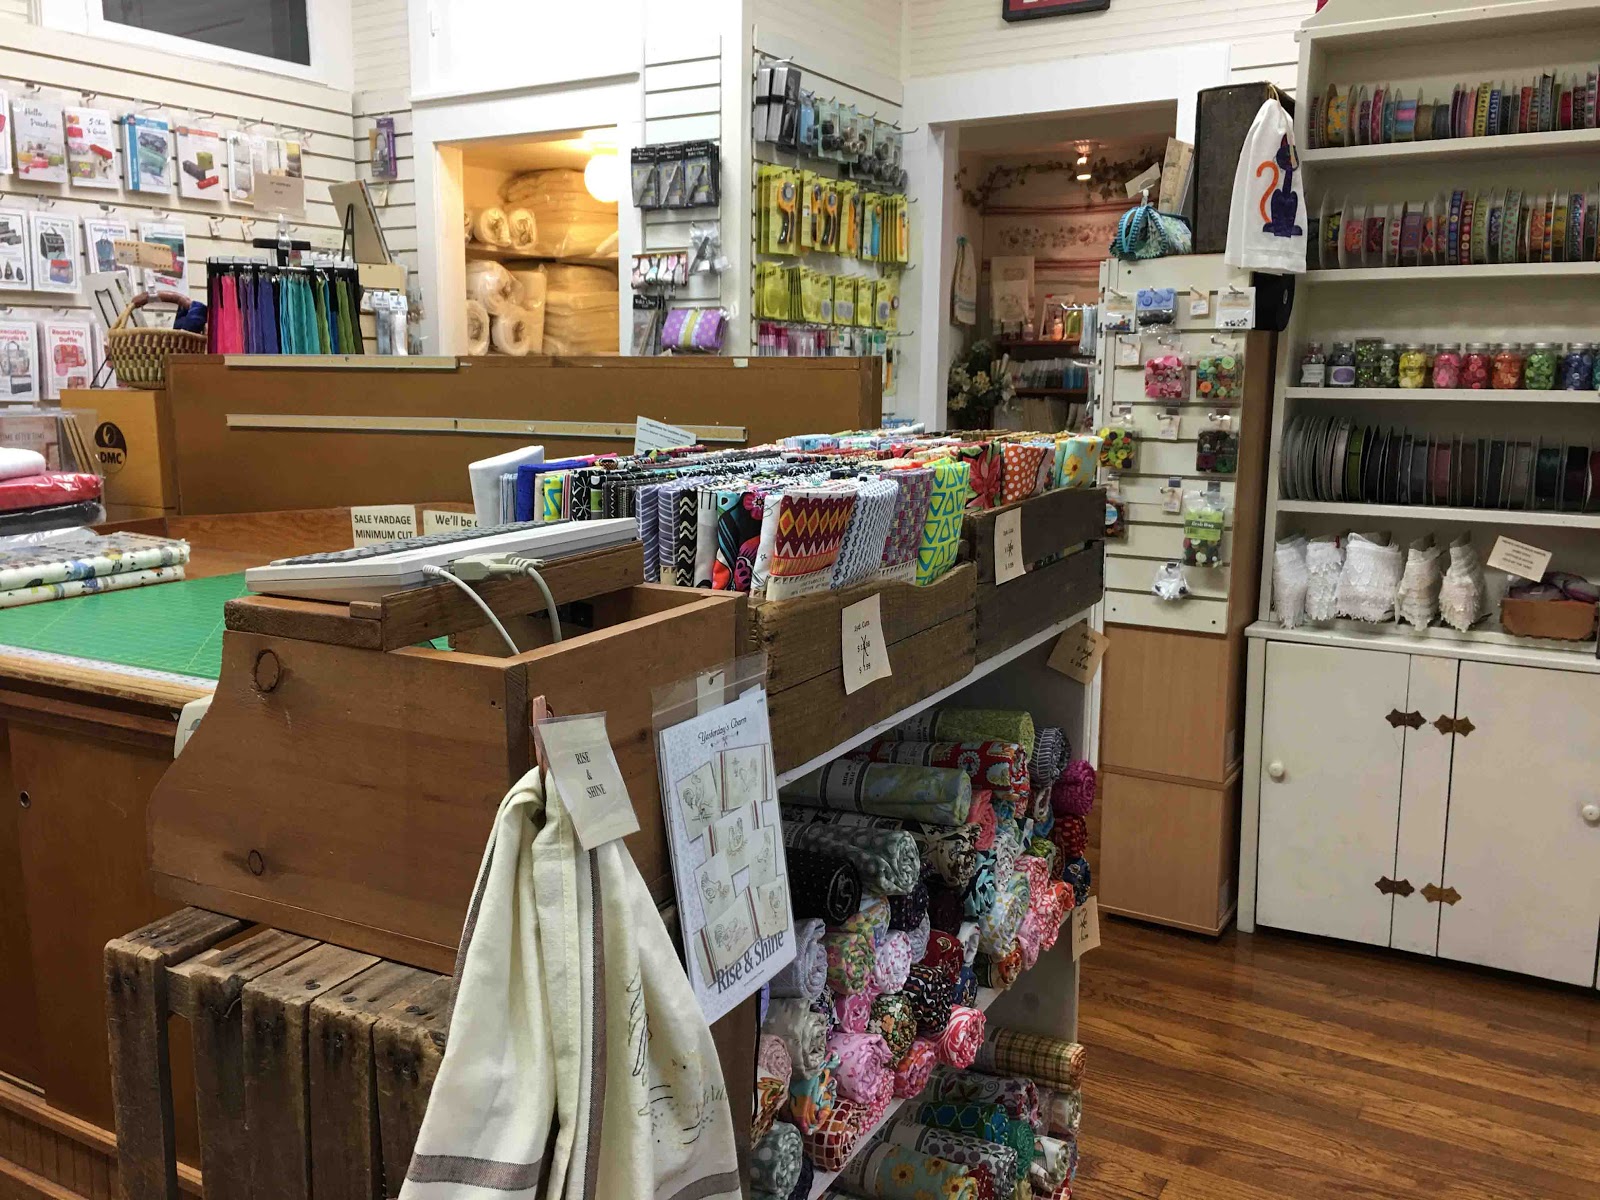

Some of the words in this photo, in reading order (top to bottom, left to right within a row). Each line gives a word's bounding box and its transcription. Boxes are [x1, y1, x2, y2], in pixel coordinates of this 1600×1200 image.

[100, 452, 122, 464] DMC
[354, 514, 372, 524] SALE
[374, 515, 412, 525] YARDAGE
[460, 516, 472, 527] be
[356, 530, 395, 539] MINIMUM
[398, 531, 413, 539] CUT
[698, 724, 730, 744] Yesterday's
[730, 717, 746, 729] Charm
[575, 752, 591, 765] RISE
[586, 769, 592, 780] &
[586, 784, 606, 798] SHINE
[716, 961, 742, 994] Rise
[744, 950, 753, 974] &
[754, 930, 784, 966] Shine
